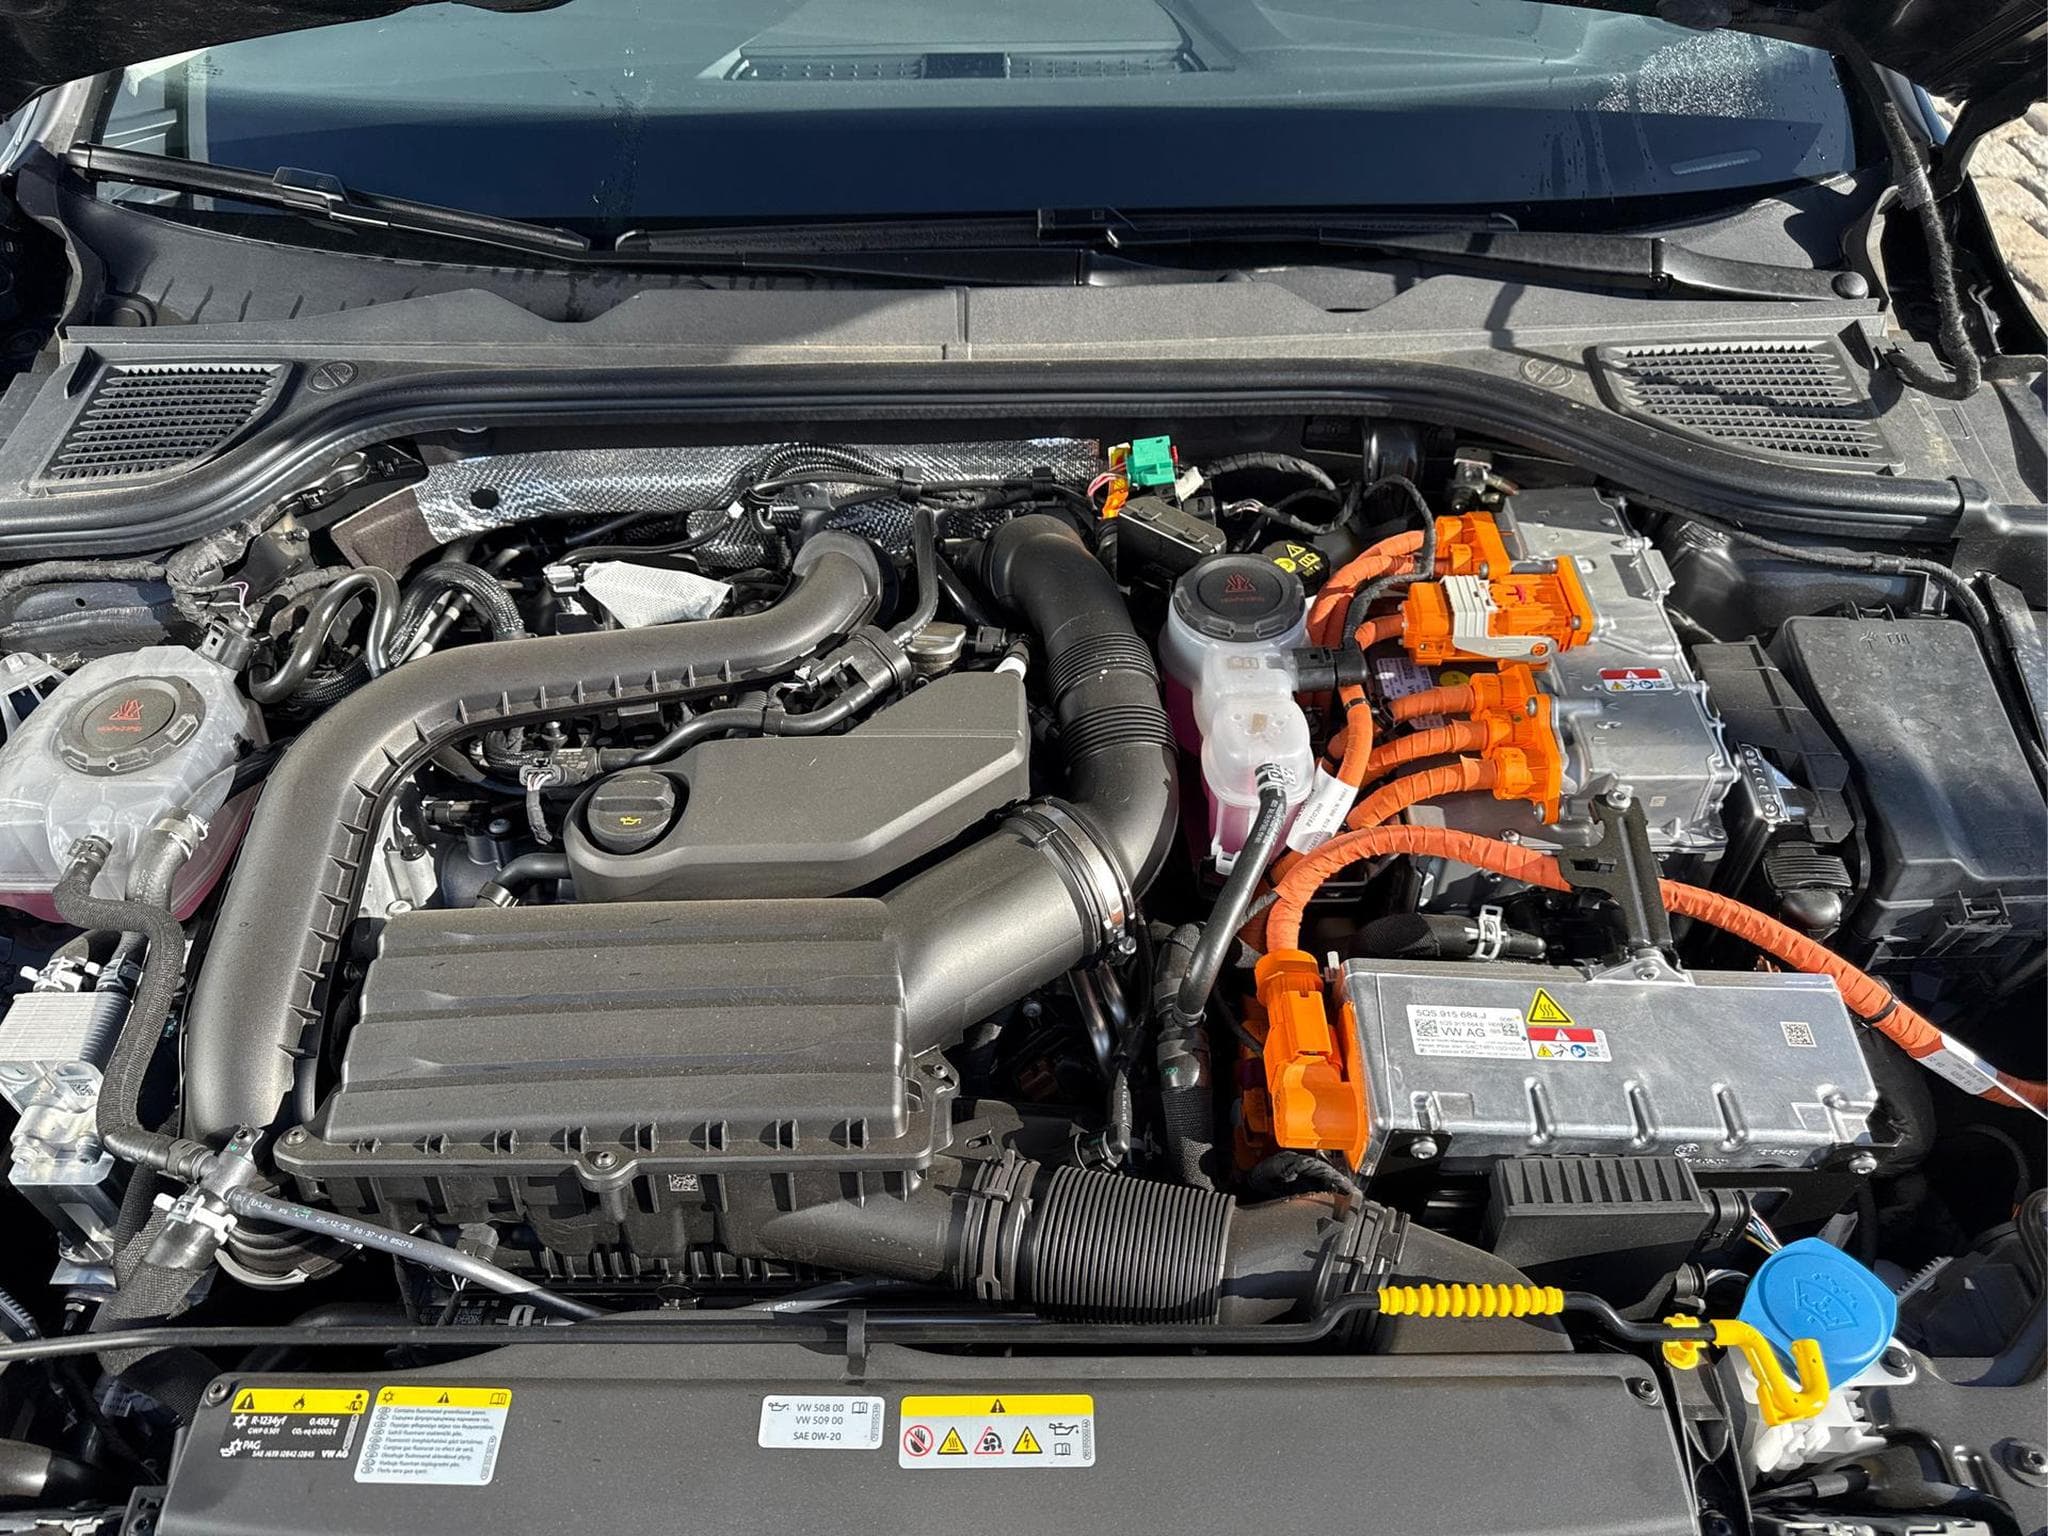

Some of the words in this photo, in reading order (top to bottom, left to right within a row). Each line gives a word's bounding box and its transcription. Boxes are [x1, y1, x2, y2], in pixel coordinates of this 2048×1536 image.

[1441, 1027, 1462, 1036] VW
[1467, 1028, 1486, 1037] AG
[797, 1404, 812, 1412] VW
[814, 1404, 831, 1412] 508
[832, 1404, 844, 1412] 00
[250, 1415, 288, 1427] R-1234yf
[795, 1416, 811, 1424] VW
[813, 1416, 830, 1424] 509
[831, 1417, 844, 1425] 00
[793, 1431, 809, 1440] SAE
[811, 1432, 842, 1441] 0W-20
[243, 1439, 262, 1450] PAG
[321, 1449, 336, 1458] VW
